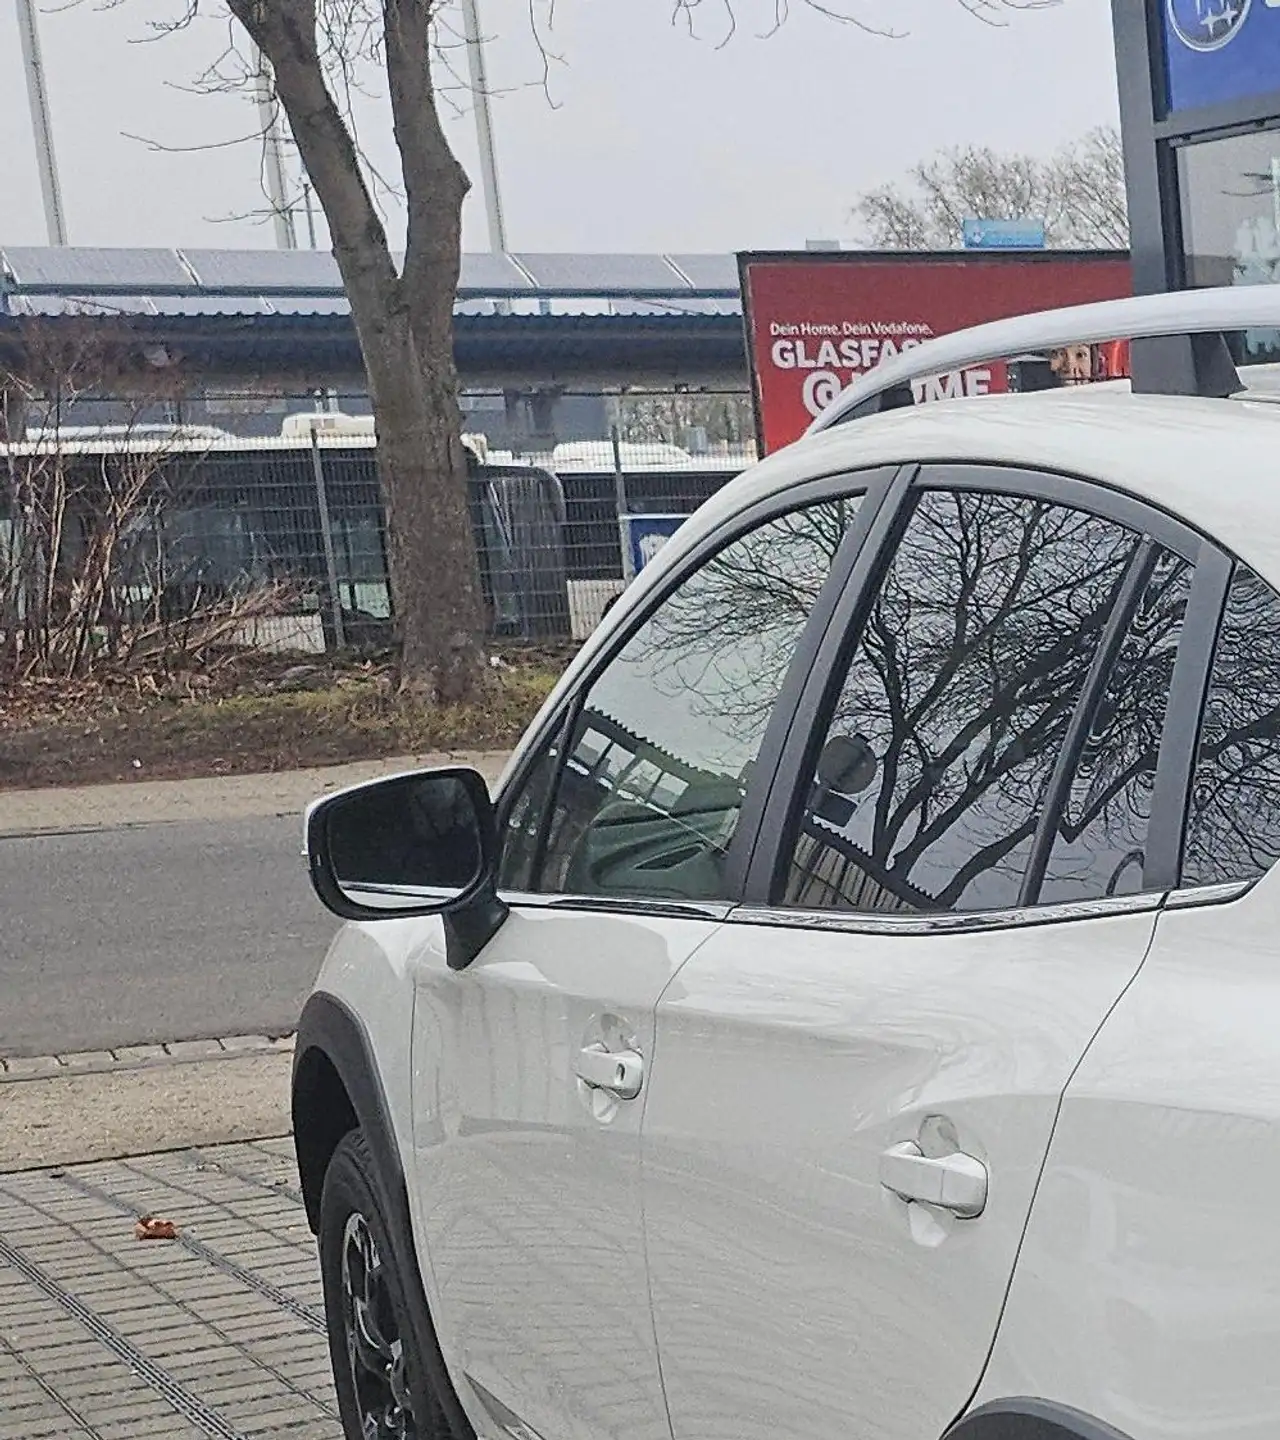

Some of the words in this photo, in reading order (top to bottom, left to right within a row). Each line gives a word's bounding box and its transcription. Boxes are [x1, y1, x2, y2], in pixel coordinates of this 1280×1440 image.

[770, 322, 800, 336] Dein
[801, 322, 841, 336] Home.
[843, 321, 871, 335] Dein
